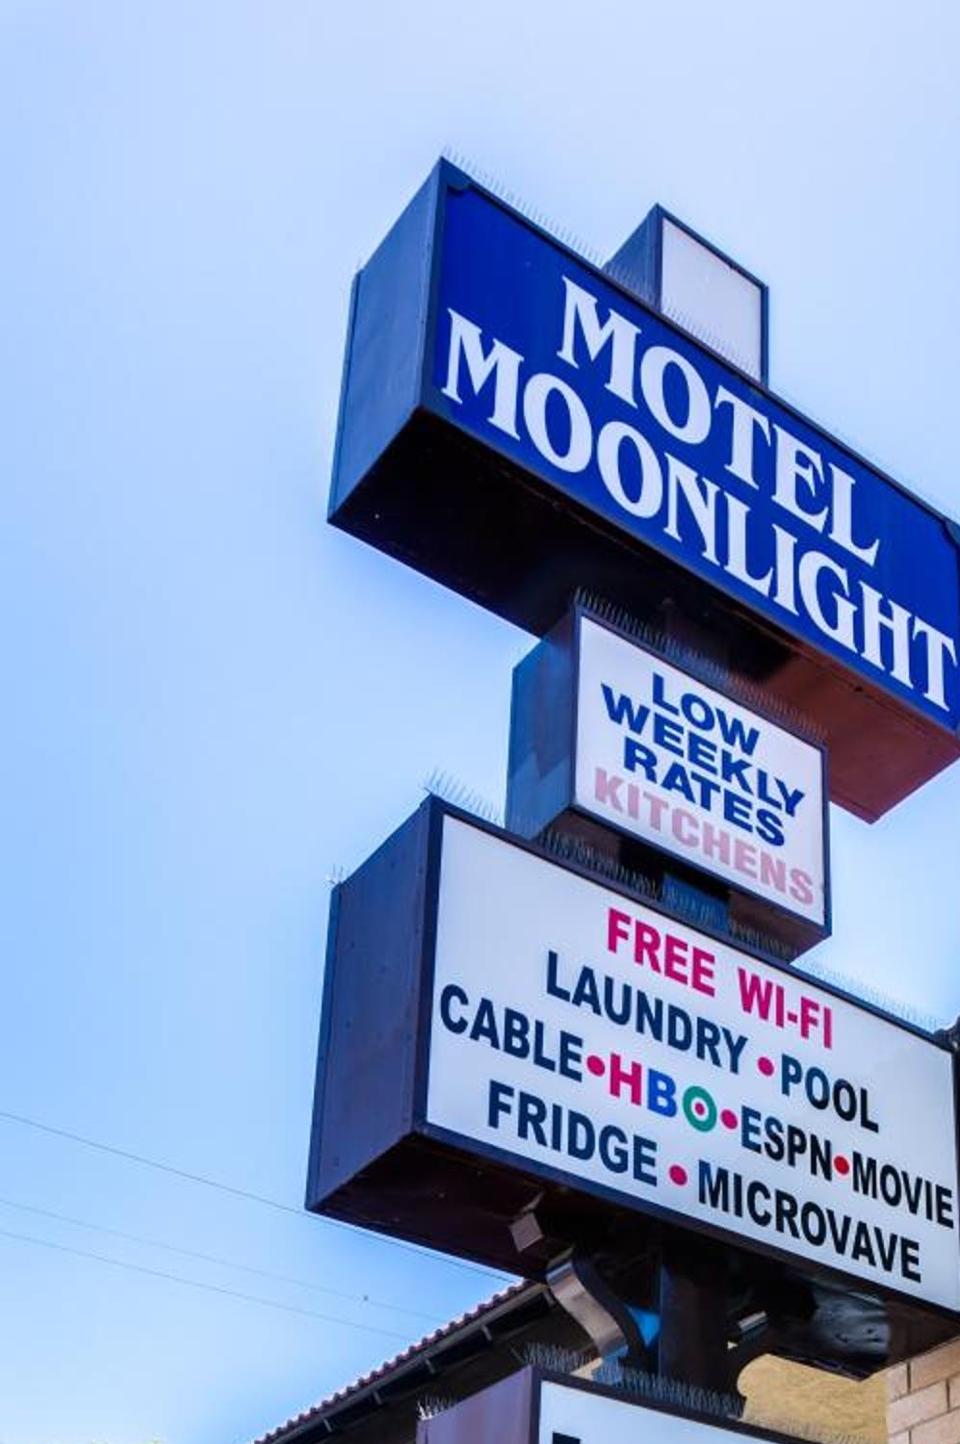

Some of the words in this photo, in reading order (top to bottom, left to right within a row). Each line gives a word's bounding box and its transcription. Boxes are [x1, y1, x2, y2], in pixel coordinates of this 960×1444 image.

[557, 275, 881, 567] MOTEL
[441, 307, 958, 713] MOONLIGHT
[600, 682, 806, 818] WEEKLY
[652, 672, 761, 756] LOW
[594, 767, 815, 906] KITCHENS
[623, 736, 786, 848] RATES
[546, 950, 749, 1075] LAUNDRY
[781, 1053, 880, 1134] POOL
[607, 907, 716, 998] FREE
[737, 967, 833, 1049] WI-FI
[487, 1079, 658, 1188] FRIDGE
[698, 1159, 922, 1284] MICROVAVE
